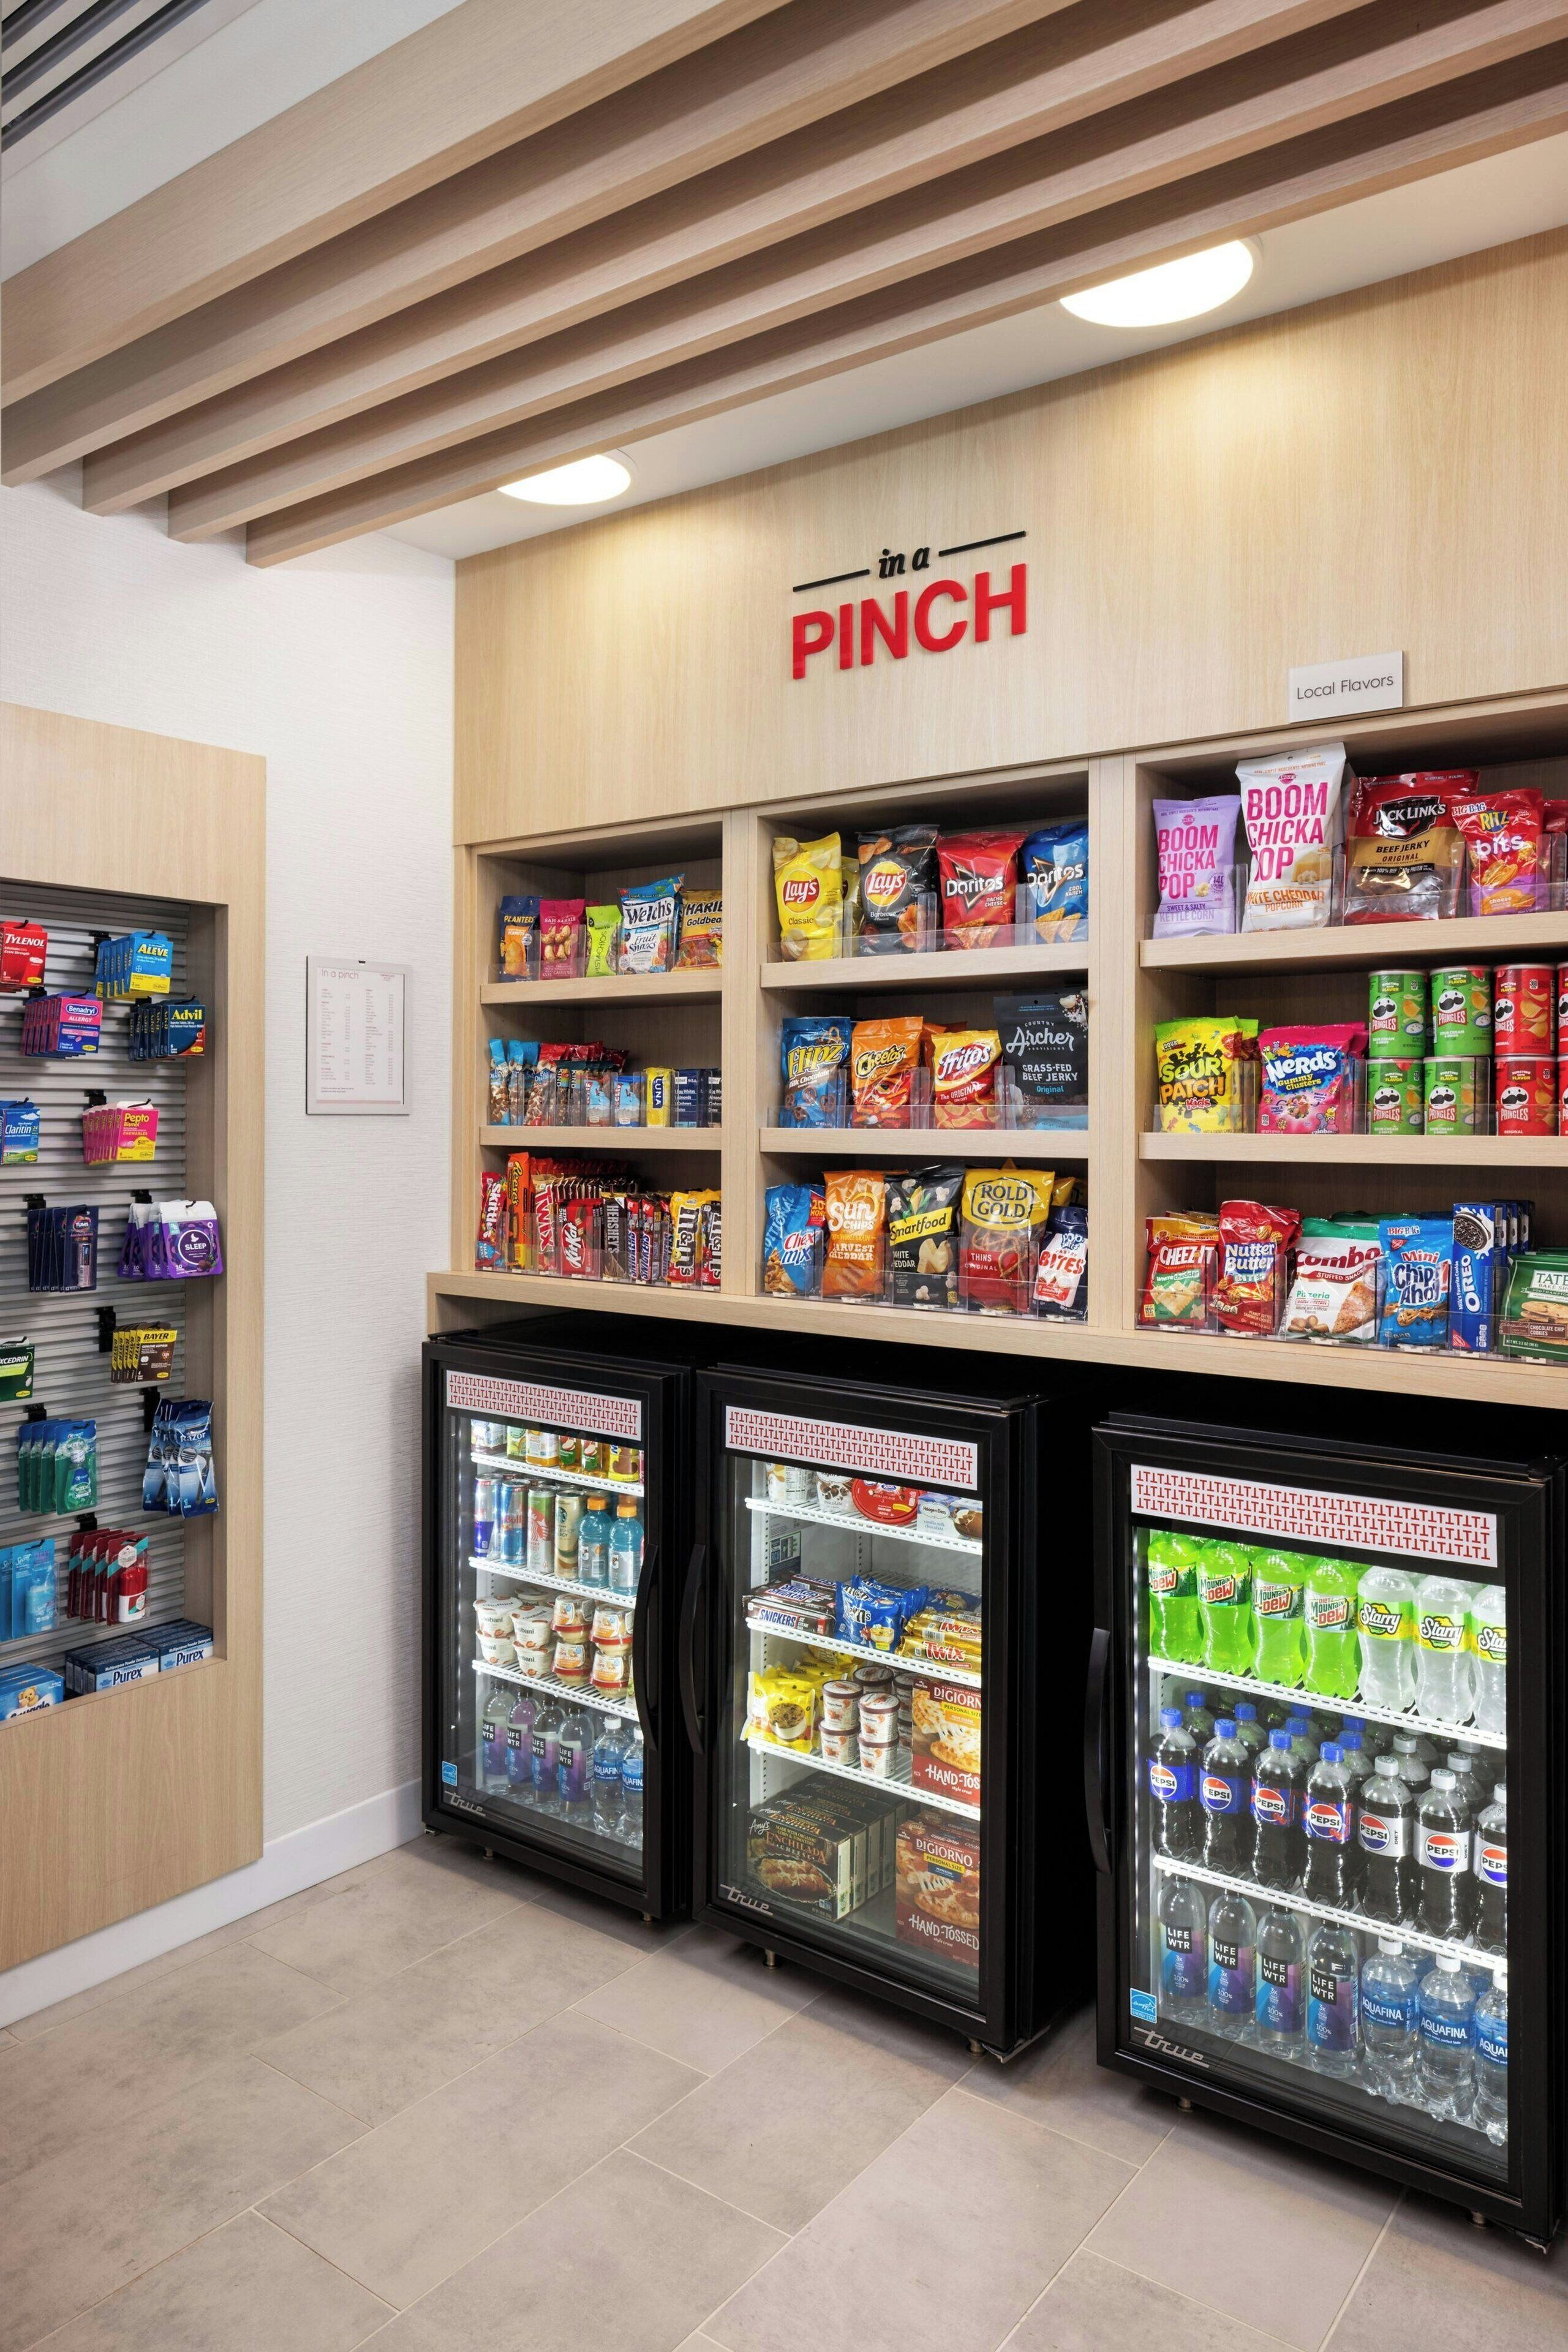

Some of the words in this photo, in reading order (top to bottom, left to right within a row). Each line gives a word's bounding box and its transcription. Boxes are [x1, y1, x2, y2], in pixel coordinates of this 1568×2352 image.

[878, 549, 905, 579] in
[912, 547, 930, 571] a
[793, 563, 1027, 680] PINCH
[1297, 682, 1335, 699] Local
[1341, 676, 1393, 693] Flavors
[1247, 783, 1328, 821] BOOM
[1452, 805, 1467, 816] BIG
[1468, 802, 1487, 815] BAG
[1408, 804, 1446, 820] LINK'S
[1480, 810, 1510, 831] RITZ
[1159, 825, 1218, 853] BOOM
[1247, 818, 1323, 848] CHICKA
[1377, 845, 1400, 853] BEEF
[1400, 840, 1430, 852] JERKY
[1476, 835, 1524, 858] bits
[1159, 850, 1215, 873] CHICKA
[1382, 853, 1419, 862] ORIGINAL
[1027, 864, 1084, 888] Doritos
[867, 872, 907, 896] Lay's
[946, 876, 1004, 897] Doritos
[1160, 873, 1195, 899] POP
[785, 880, 816, 903] Lay's
[1273, 890, 1324, 903] CHEDDAR
[625, 901, 672, 924] Welch's
[1265, 900, 1303, 912] POPCORN
[788, 917, 813, 925] Classic
[1159, 912, 1190, 922] KETTLE
[1192, 910, 1215, 920] CORN
[6, 933, 45, 947] TYLENOL
[635, 933, 657, 946] Fruit
[137, 943, 169, 957] ALEVE
[595, 930, 607, 974] PISTACHIOS
[68, 1005, 96, 1015] Benadryl
[171, 1009, 203, 1020] Advil
[1439, 1010, 1466, 1024] PRINGLES
[1372, 1017, 1396, 1031] PRINGLES
[1006, 1027, 1074, 1057] Archer
[788, 1042, 845, 1078] Flipz
[856, 1044, 907, 1077] Cheetos
[938, 1045, 992, 1080] Fritos
[1022, 1063, 1072, 1072] GRASS-FED
[1161, 1057, 1221, 1084] SOUR
[1022, 1072, 1042, 1081] BEEF
[1046, 1072, 1078, 1082] JERKY
[1278, 1074, 1313, 1087] Gummy
[1036, 1085, 1065, 1095] Original
[1161, 1077, 1225, 1104] PATCH
[1286, 1078, 1321, 1091] Clusters
[1186, 1098, 1212, 1110] Kids
[124, 1112, 149, 1123] Pepto
[1373, 1109, 1400, 1121] PRINGLES
[1429, 1108, 1455, 1121] PRINGLES
[1501, 1108, 1529, 1121] PRINGLES
[5, 1125, 31, 1134] Claritin
[981, 1183, 1028, 1201] ROLD
[829, 1201, 875, 1232] Sun
[978, 1201, 1025, 1218] GOLD
[535, 1185, 555, 1253] TWIX
[843, 1220, 875, 1231] CHIPS
[607, 1205, 619, 1254] HERSHEY'S
[890, 1211, 947, 1242] Smartfood
[675, 1207, 700, 1276] m&m's
[784, 1232, 815, 1250] Chex
[780, 1248, 812, 1265] mix
[1226, 1243, 1275, 1257] Nutter
[971, 1253, 992, 1262] THINS
[1039, 1251, 1086, 1275] BITES
[1226, 1257, 1275, 1270] Butter
[1401, 1251, 1439, 1264] Mini
[1234, 1273, 1266, 1283] BITES
[1461, 1255, 1481, 1313] OREO
[143, 1332, 170, 1341] BAYER
[0, 1355, 29, 1365] XCEDRIN
[180, 1431, 206, 1442] Razor
[759, 1609, 796, 1627] SNICKERS
[1360, 1603, 1401, 1634] Starry
[1419, 1616, 1464, 1647] Starry
[176, 1649, 204, 1666] Purex
[924, 1642, 965, 1661] TWIX
[113, 1667, 142, 1686] Purex
[944, 1705, 970, 1714] PERSONAL
[483, 1723, 494, 1732] LIFE
[482, 1731, 494, 1740] WTR
[507, 1730, 520, 1740] LIFE
[507, 1738, 519, 1747] WTR
[532, 1738, 544, 1748] LIFE
[532, 1747, 544, 1757] WTR
[559, 1747, 572, 1757] LIFE
[559, 1755, 572, 1765] WTR
[594, 1765, 622, 1775] AQUAFINA
[1152, 1775, 1175, 1787] PEPSI
[1256, 1798, 1284, 1811] PEPSI
[749, 1819, 770, 1835] Amy's
[1311, 1814, 1340, 1826] PEPSI
[1361, 1825, 1387, 1840] PEPSI
[766, 1831, 827, 1866] ENCHILADA
[916, 1839, 973, 1867] DIGIORNO
[1427, 1845, 1459, 1856] PEPSI
[926, 1856, 951, 1868] PERSONAL
[908, 1914, 979, 1951] HAND-TOSSED
[1167, 1928, 1190, 1939] LIFE
[1167, 1937, 1190, 1950] WTR
[1215, 1941, 1236, 1955] LIFE
[1215, 1951, 1236, 1966] WTR
[1264, 1958, 1285, 1972] LIFE
[1264, 1968, 1285, 1983] WTR
[1313, 1974, 1334, 1990] LIFE
[1218, 1989, 1233, 1999] 100%
[1312, 1984, 1334, 2000] WTR
[1267, 2007, 1283, 2018] 100%
[1362, 1996, 1404, 2021] AQUAFINA
[1316, 2024, 1332, 2035] 100%
[1420, 2017, 1468, 2039] AQUAFINA
[1134, 2026, 1210, 2068] true
